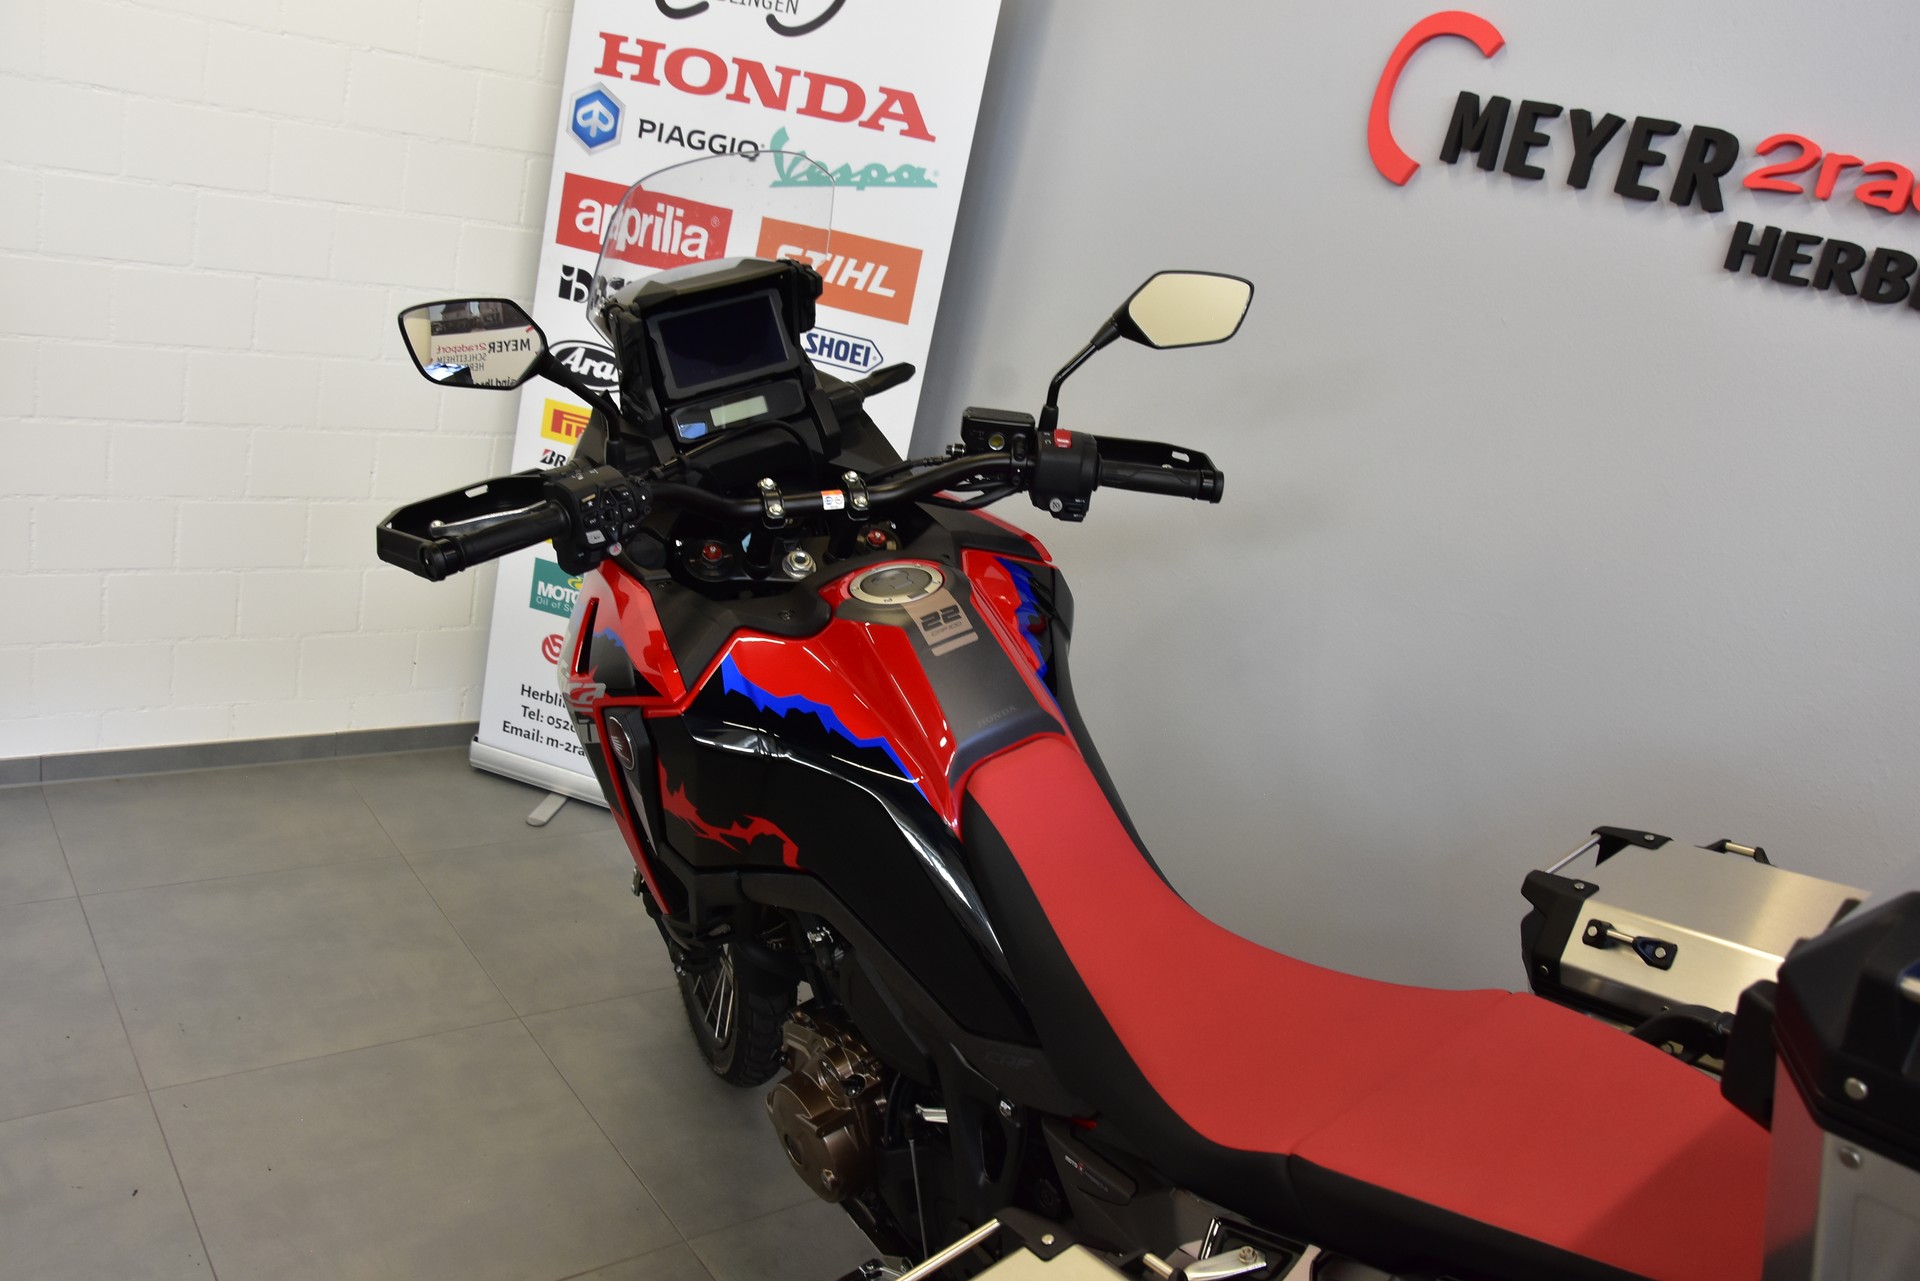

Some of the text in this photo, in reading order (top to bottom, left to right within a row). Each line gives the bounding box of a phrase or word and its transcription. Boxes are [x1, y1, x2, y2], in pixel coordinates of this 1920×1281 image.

[594, 32, 936, 142] HONDA
[638, 118, 760, 161] PIAGGIO
[769, 126, 938, 190] Vespa
[1439, 90, 1920, 215] MEYER 2ra
[574, 198, 709, 260] aprilia
[1723, 220, 1920, 311] HERB
[805, 332, 871, 367] SHOEI
[536, 596, 549, 606] Oil
[502, 720, 544, 744] Email:
[521, 705, 544, 723] Tel:
